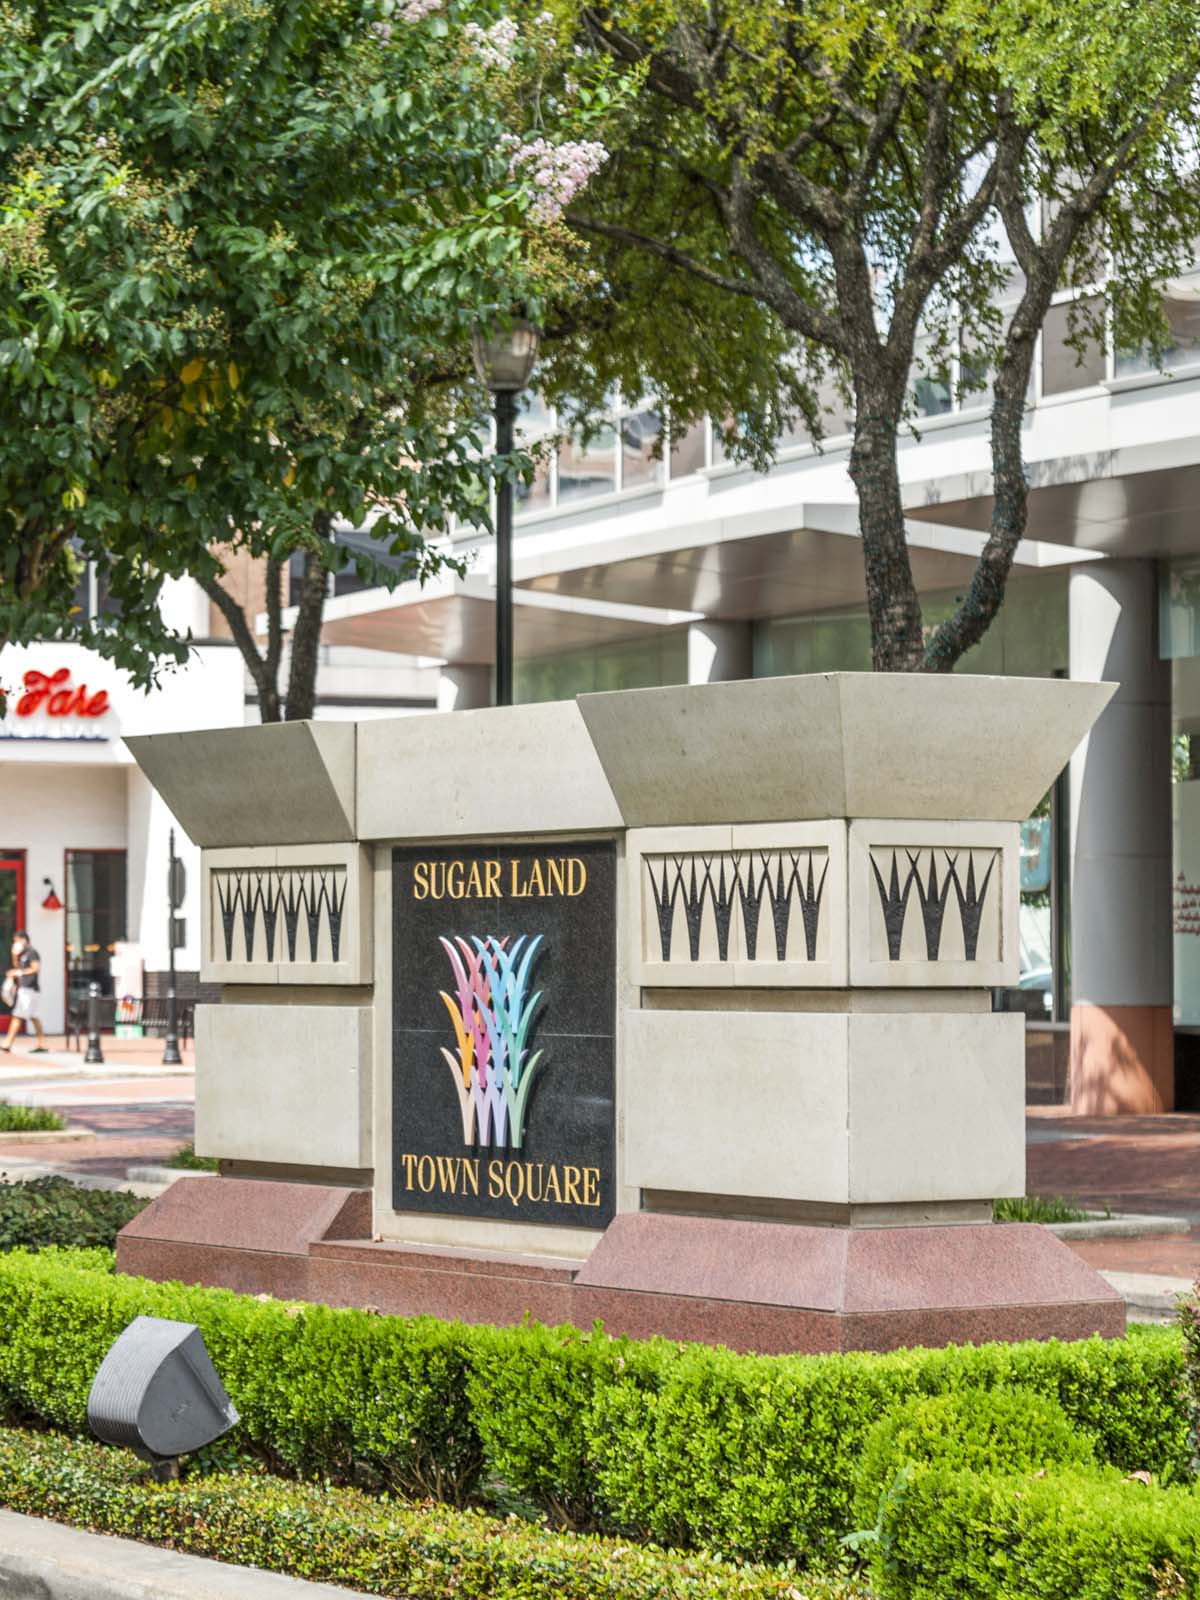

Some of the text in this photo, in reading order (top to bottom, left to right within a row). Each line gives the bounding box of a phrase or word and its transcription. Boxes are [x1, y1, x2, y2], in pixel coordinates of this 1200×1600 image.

[15, 667, 110, 718] Fare
[413, 858, 587, 900] SUGAR LAND
[402, 1154, 601, 1206] TOWN SQUARE
